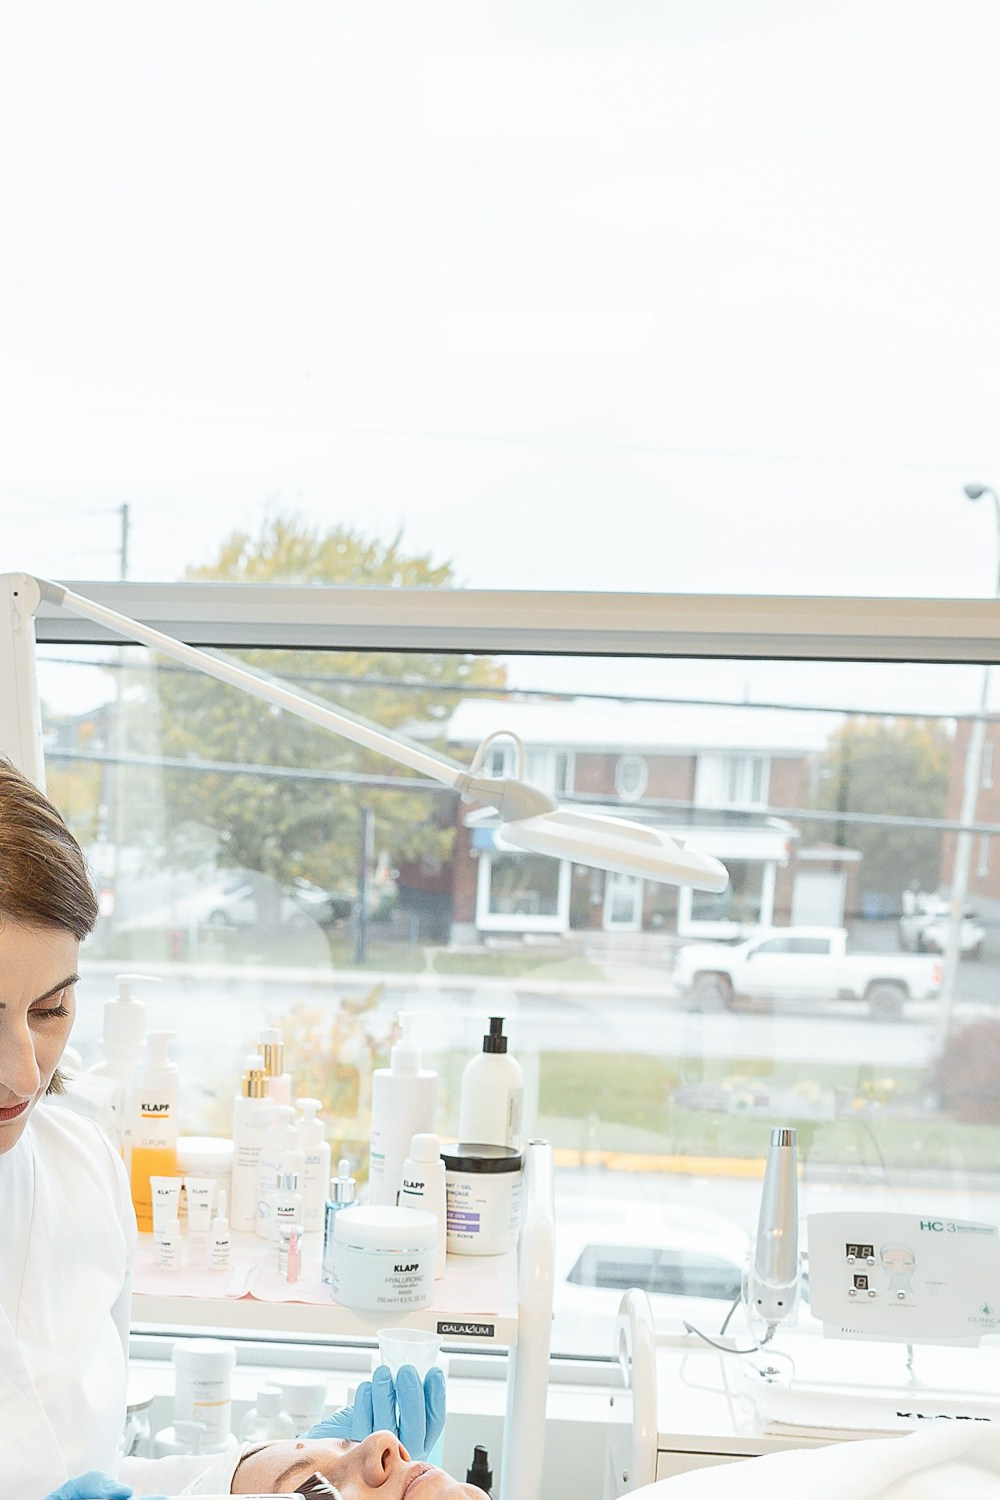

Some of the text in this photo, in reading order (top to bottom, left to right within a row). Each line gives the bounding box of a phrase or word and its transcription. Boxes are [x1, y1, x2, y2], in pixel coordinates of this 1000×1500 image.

[141, 1103, 170, 1112] KLAPP
[403, 1179, 425, 1189] KLAPP
[920, 1221, 944, 1232] HC
[947, 1223, 956, 1233] 3
[393, 1264, 419, 1273] KLAPP
[384, 1275, 425, 1284] HYALURONIC
